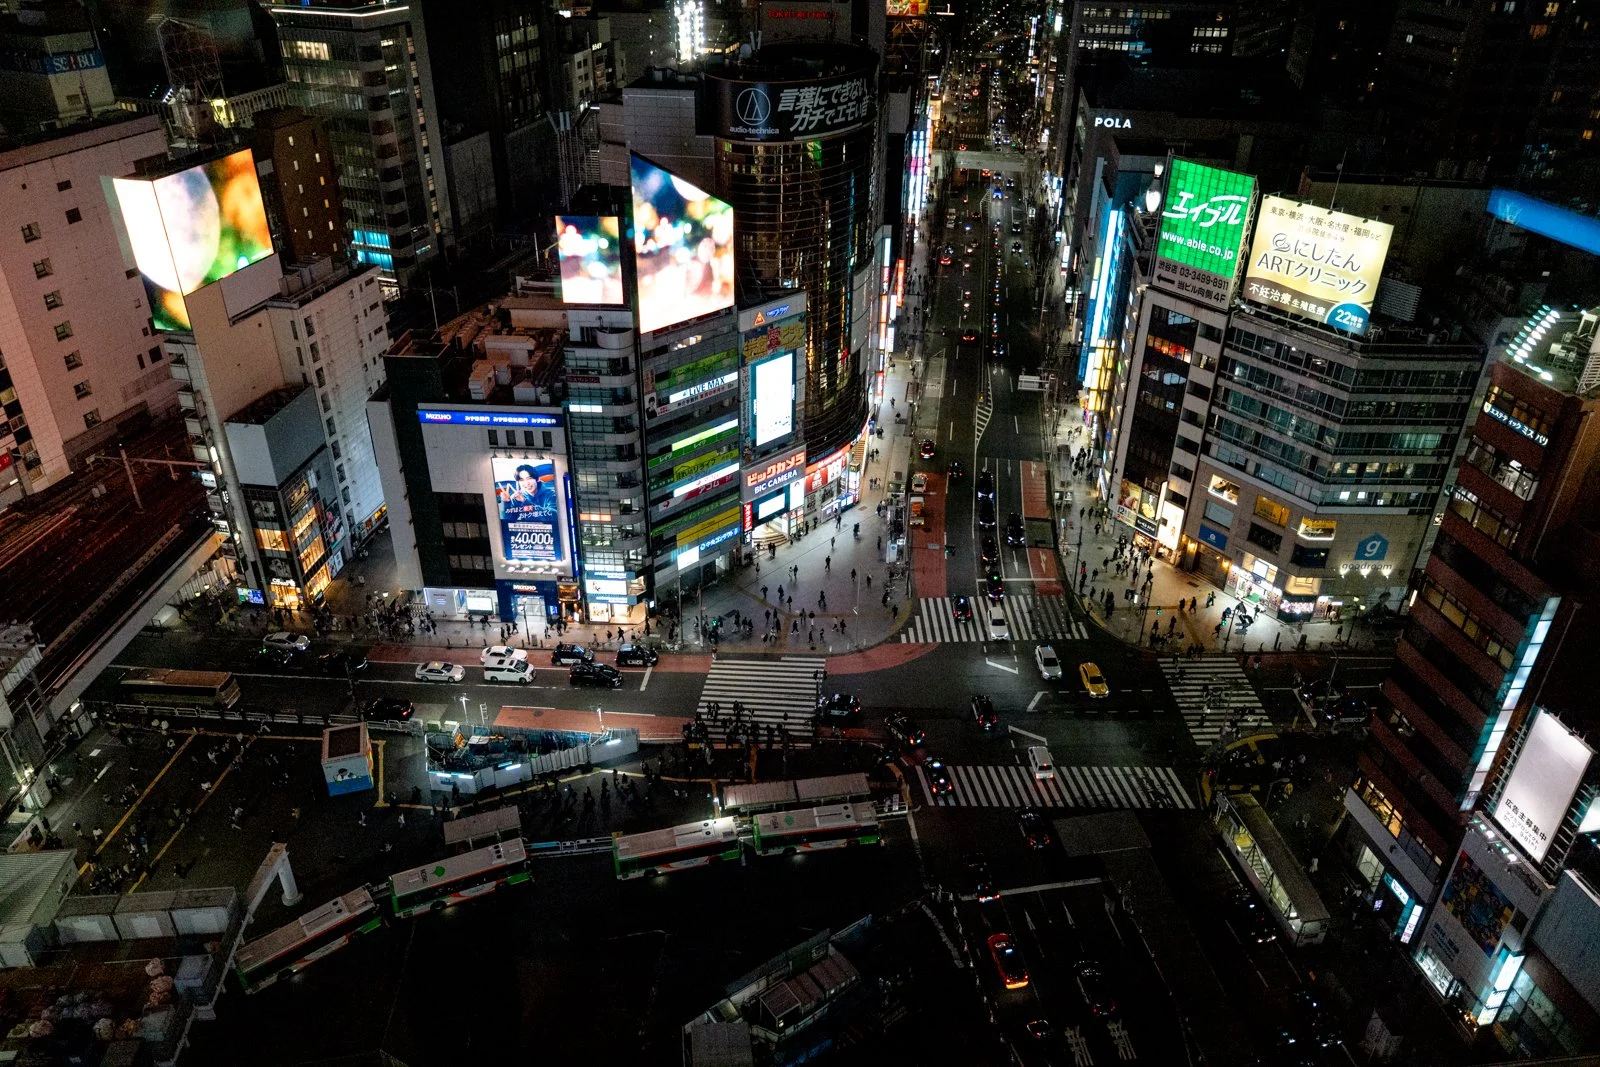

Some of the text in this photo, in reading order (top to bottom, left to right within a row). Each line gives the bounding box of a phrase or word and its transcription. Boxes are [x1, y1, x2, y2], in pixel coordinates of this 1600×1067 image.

[53, 53, 96, 72] SEIBU
[778, 78, 869, 112] 言葉にできない
[730, 126, 779, 134] audio-technica
[1094, 117, 1132, 129] POLA
[1162, 191, 1247, 227] エイブル
[1161, 231, 1234, 261] www.able.co.jp
[1294, 240, 1361, 272] にしたん
[1179, 266, 1229, 293] 03-3499-8911
[1257, 253, 1367, 294] ARTクリニック
[1249, 283, 1291, 306] 不妊治療
[707, 376, 726, 391] MAX
[425, 413, 452, 421] MIZUHO
[747, 452, 805, 487] ビックカメラ
[699, 481, 721, 497] アコム
[753, 484, 767, 495] BIC
[767, 469, 798, 488] CAMERA
[515, 532, 551, 544] 40,000
[1341, 562, 1393, 571] goodroom
[1504, 797, 1547, 842] 広告主募集中
